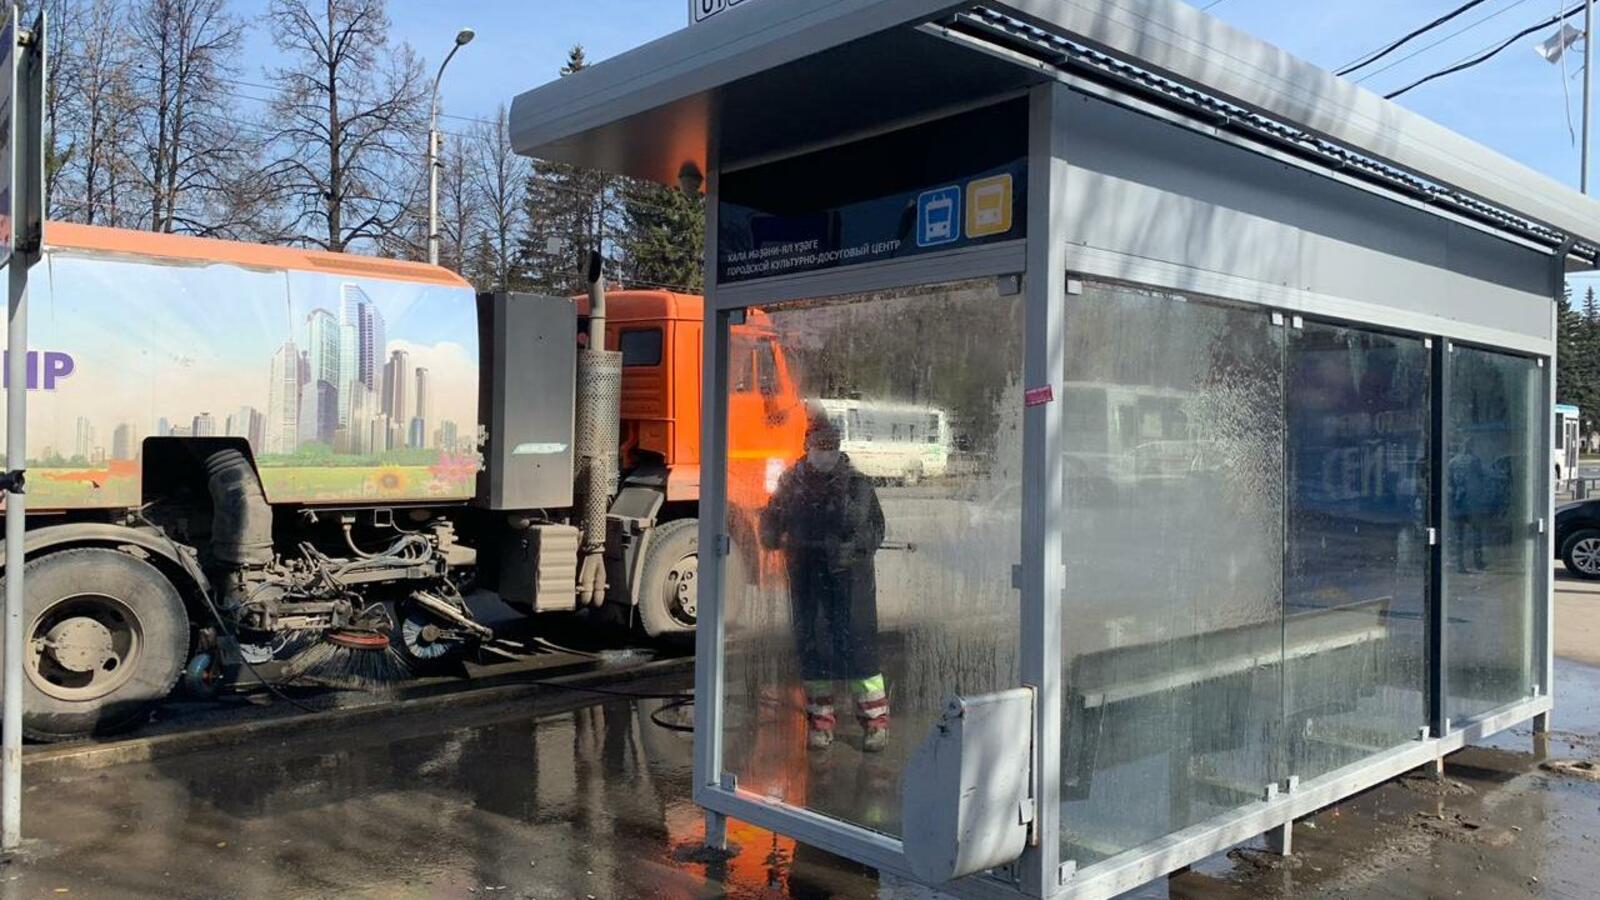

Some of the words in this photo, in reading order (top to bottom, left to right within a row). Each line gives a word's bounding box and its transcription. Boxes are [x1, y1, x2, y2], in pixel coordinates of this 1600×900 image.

[727, 260, 770, 276] ГОРОДСКОЙ
[770, 244, 869, 271] КУЛЬТУРНО-ДОСУГОВЫЙ
[871, 240, 901, 257] ЦЕНТР
